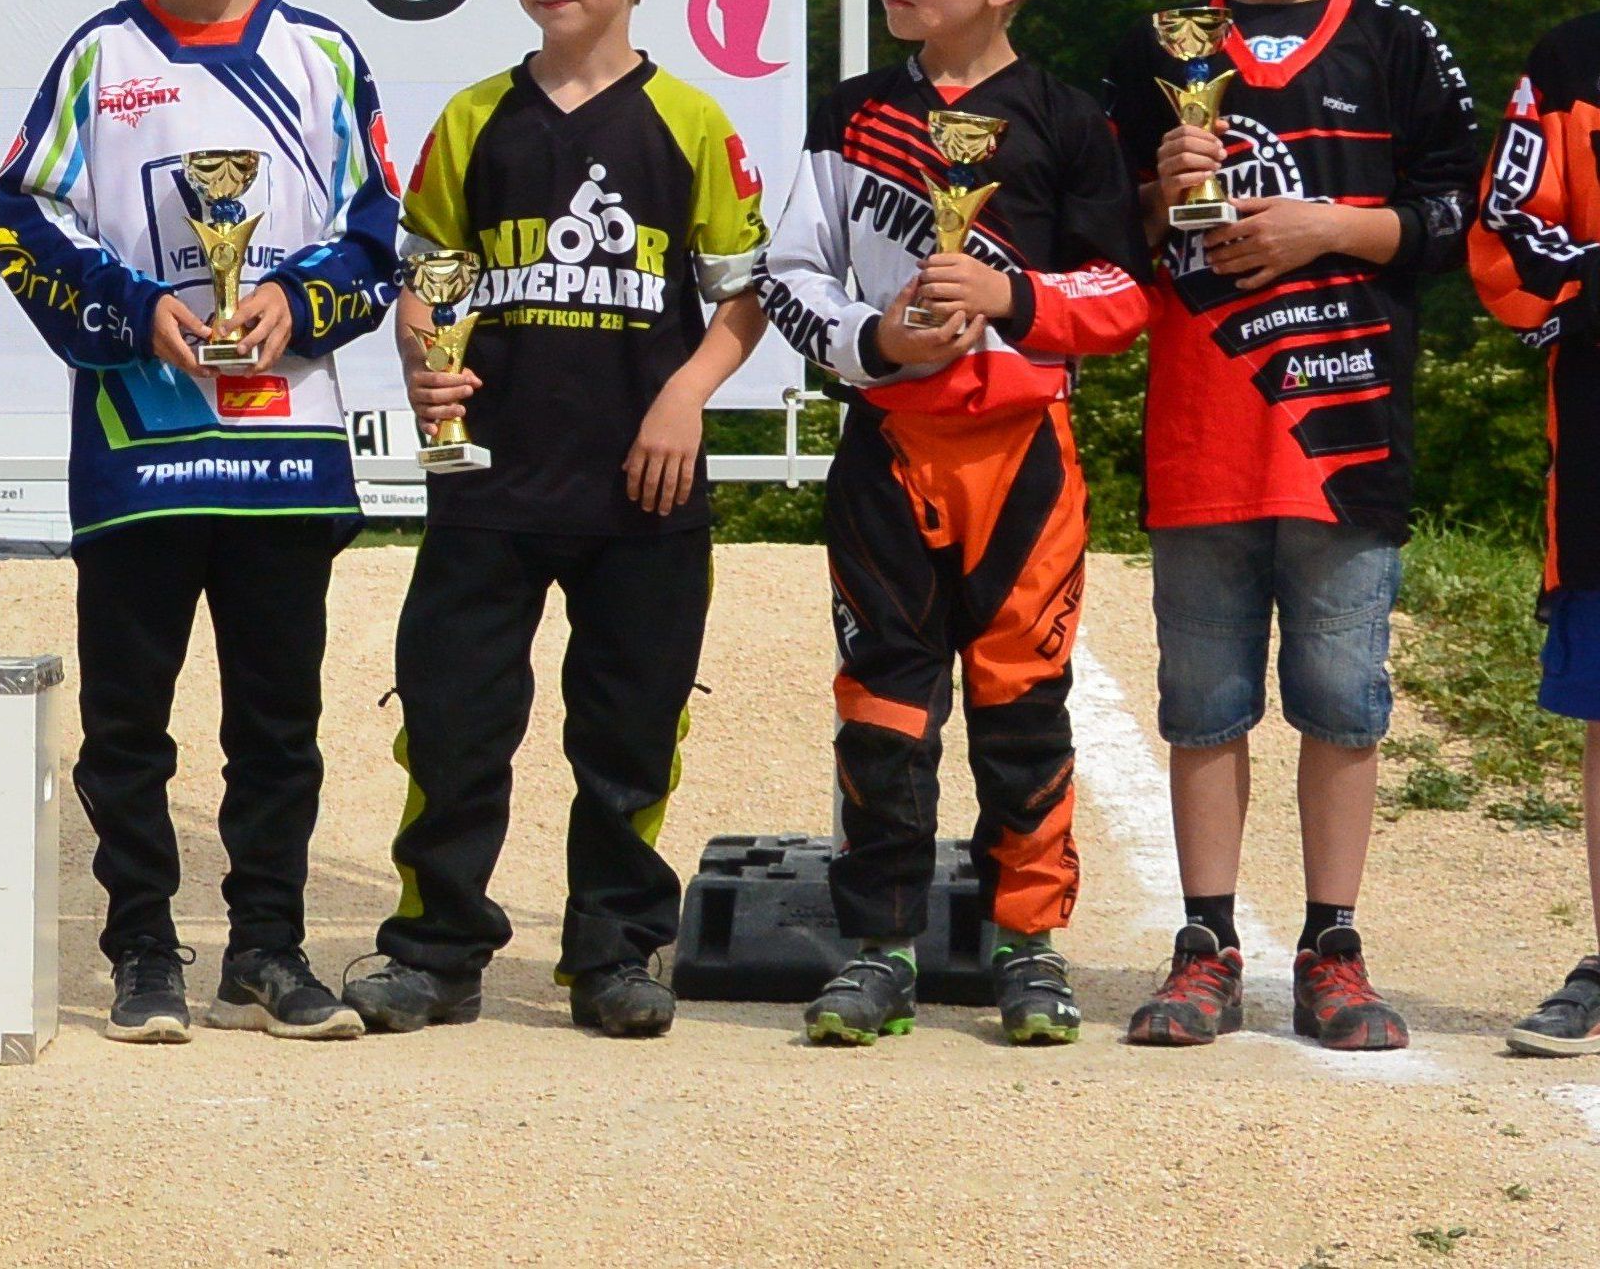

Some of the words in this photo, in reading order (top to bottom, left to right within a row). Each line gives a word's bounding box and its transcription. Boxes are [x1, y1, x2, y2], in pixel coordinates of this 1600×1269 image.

[97, 87, 180, 114] PHOENIX
[1241, 301, 1349, 340] FRIBIKE.CH
[1304, 349, 1375, 383] triplast
[137, 458, 314, 486] 7PHOENIX.CH
